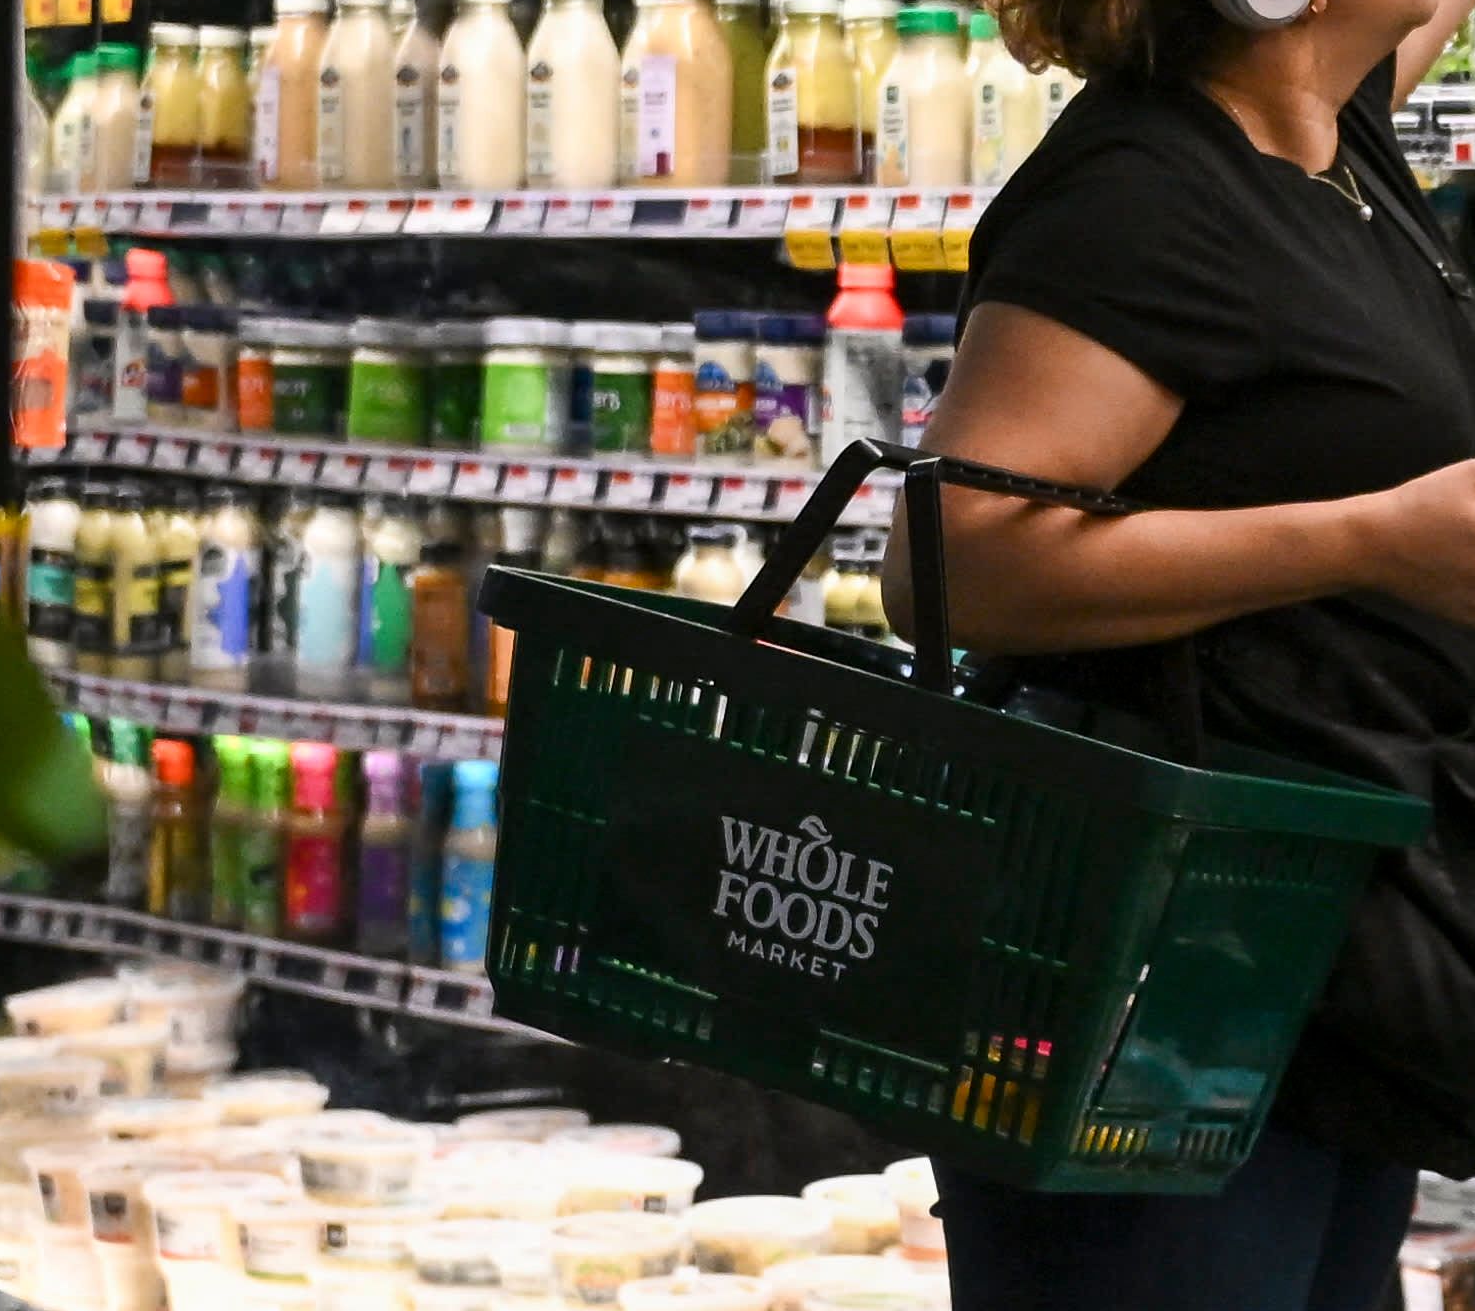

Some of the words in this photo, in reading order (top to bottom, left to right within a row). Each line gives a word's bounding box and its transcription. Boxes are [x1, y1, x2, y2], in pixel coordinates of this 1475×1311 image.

[720, 813, 895, 914] WHOLE
[712, 870, 880, 963] FOODS
[726, 928, 849, 982] MARKET
